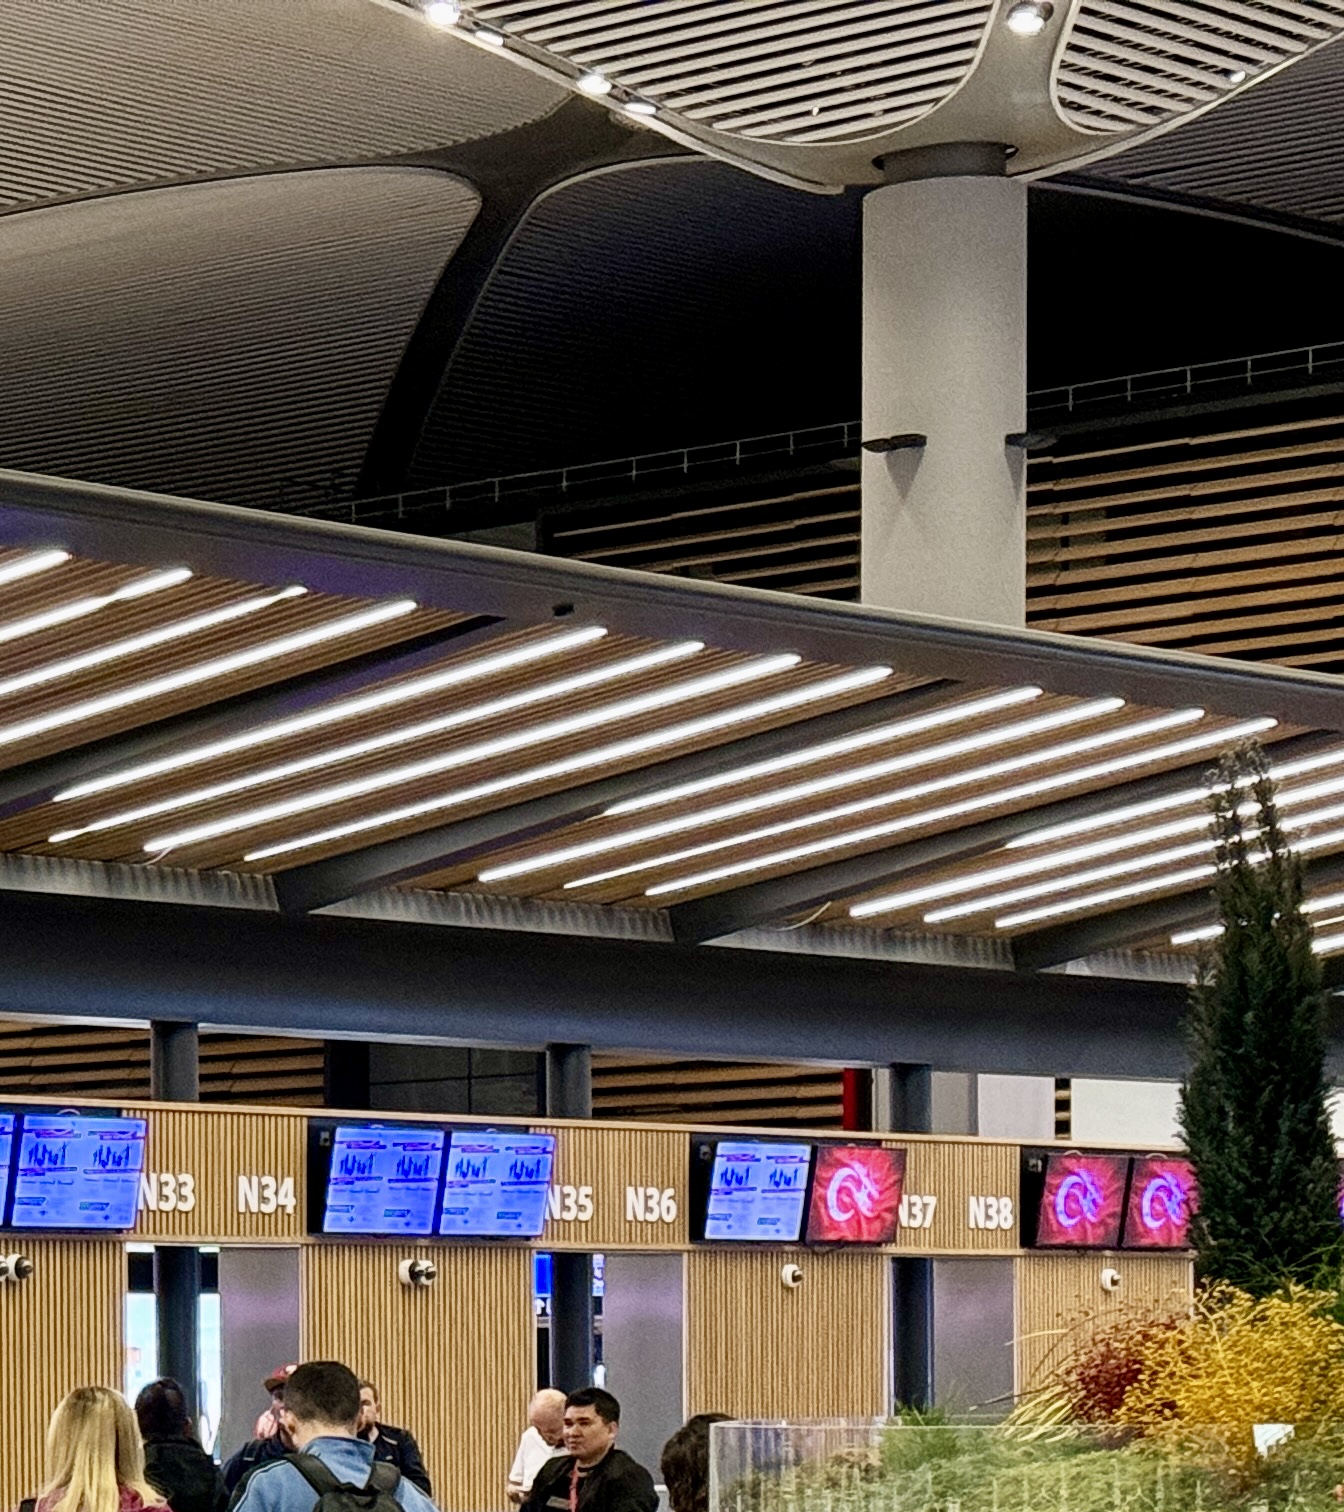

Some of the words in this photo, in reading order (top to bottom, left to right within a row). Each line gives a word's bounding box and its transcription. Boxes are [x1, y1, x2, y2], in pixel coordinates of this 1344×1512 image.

[138, 1172, 195, 1212] N33
[237, 1175, 296, 1214] N34
[545, 1184, 593, 1221] N35
[626, 1186, 677, 1223] N36
[969, 1195, 1013, 1230] N38
